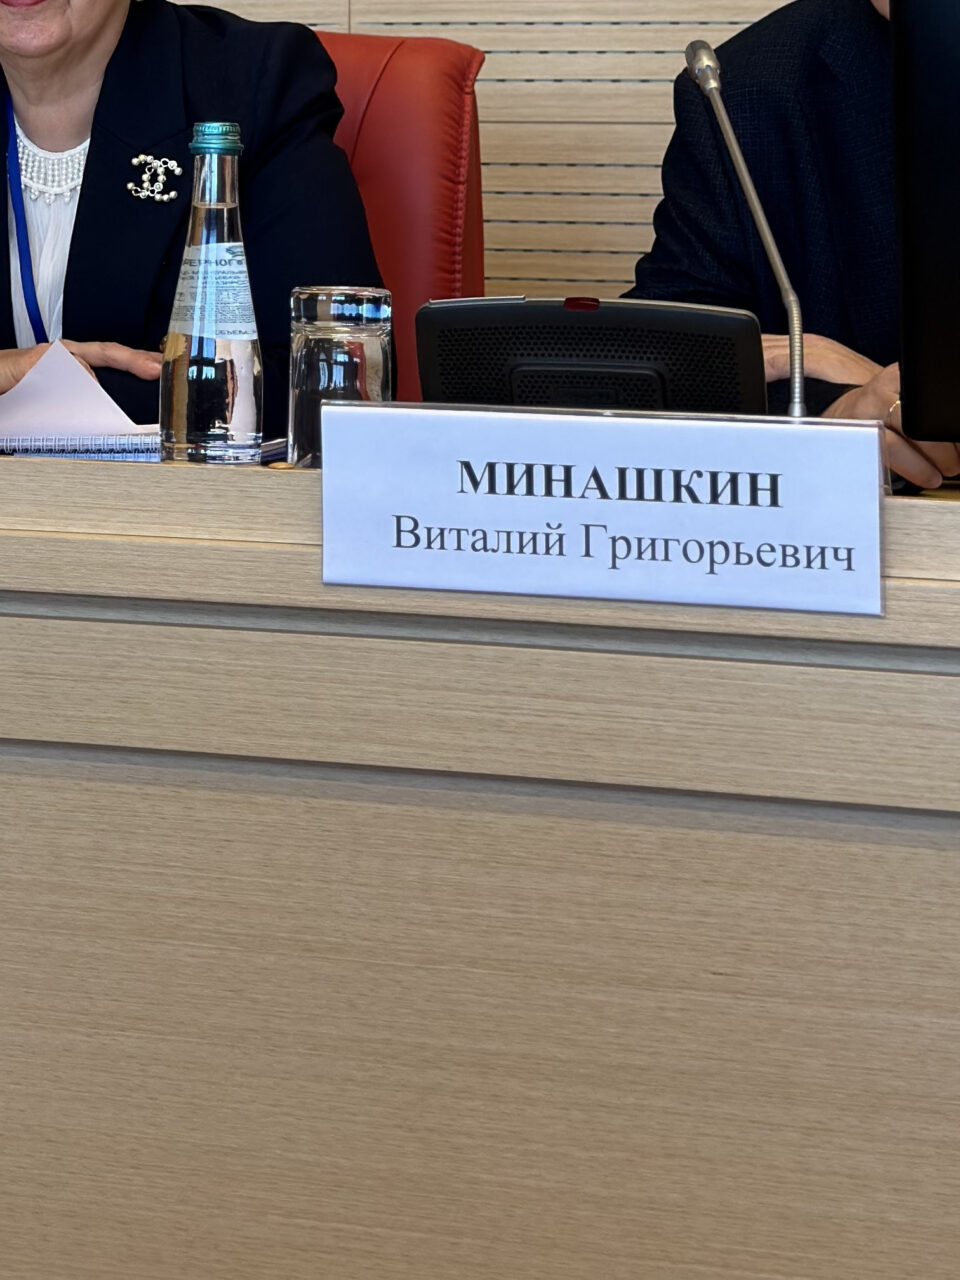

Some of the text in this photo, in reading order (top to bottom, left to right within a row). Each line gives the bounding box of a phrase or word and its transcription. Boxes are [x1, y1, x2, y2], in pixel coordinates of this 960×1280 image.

[456, 459, 784, 508] МИНАШКИН
[391, 514, 856, 576] Виталий Григорьевич
